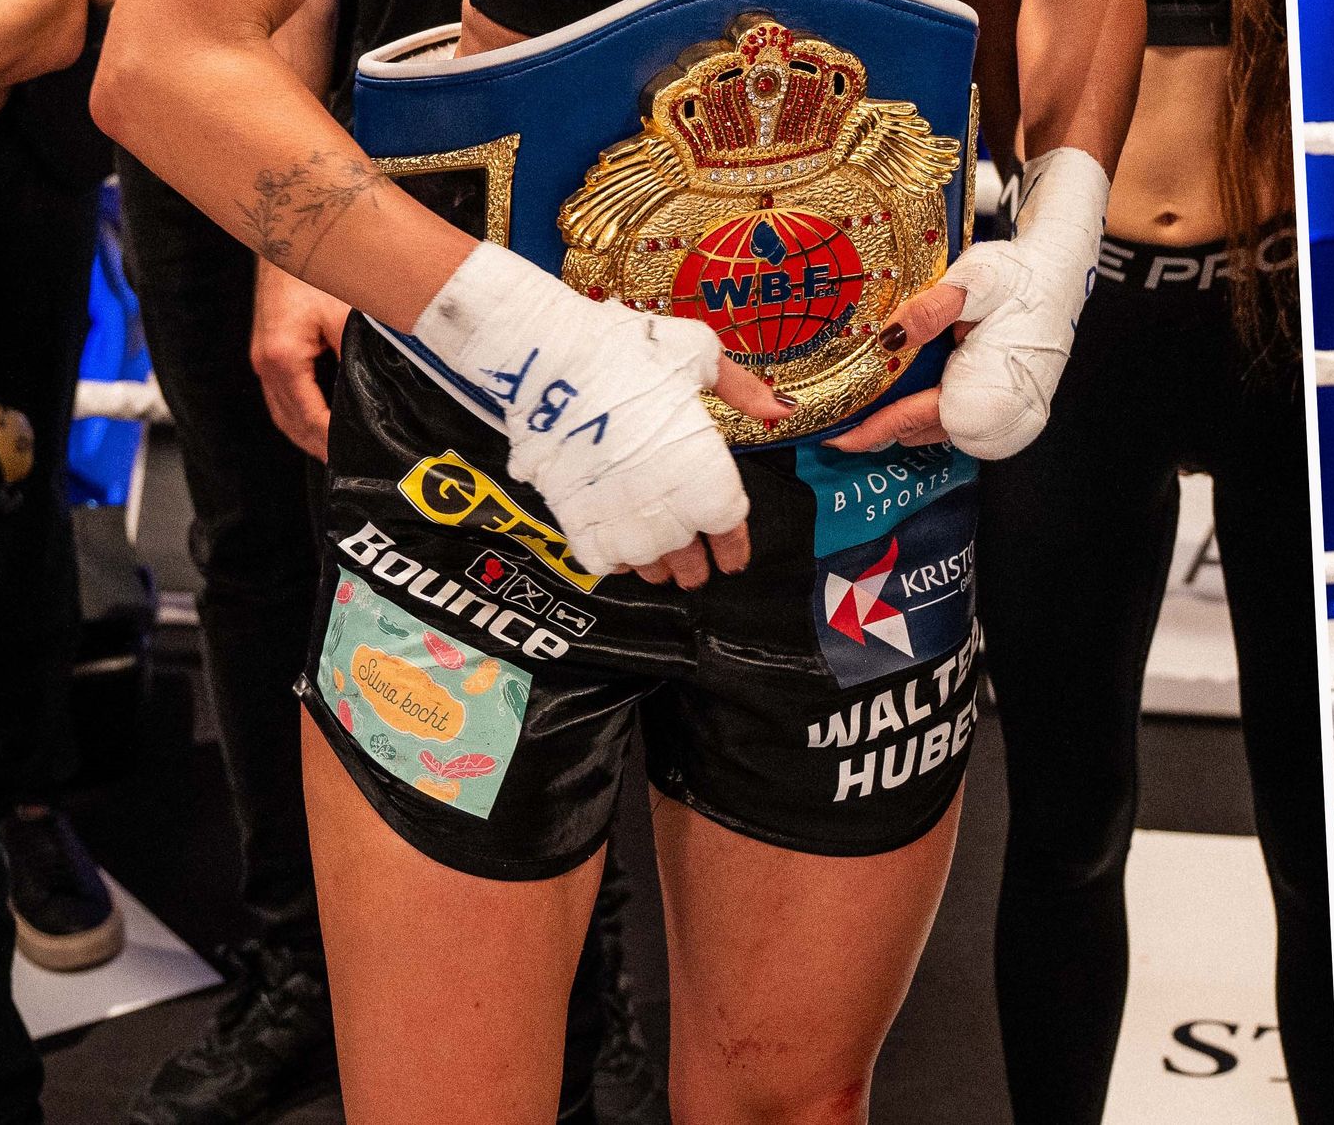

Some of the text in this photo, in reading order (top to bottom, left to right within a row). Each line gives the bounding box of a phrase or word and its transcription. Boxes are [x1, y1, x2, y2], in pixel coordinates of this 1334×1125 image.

[866, 467, 950, 522] SPORTS
[337, 520, 570, 660] Bounce
[900, 539, 975, 598] KRISTO
[358, 657, 450, 733] Silvia kocht
